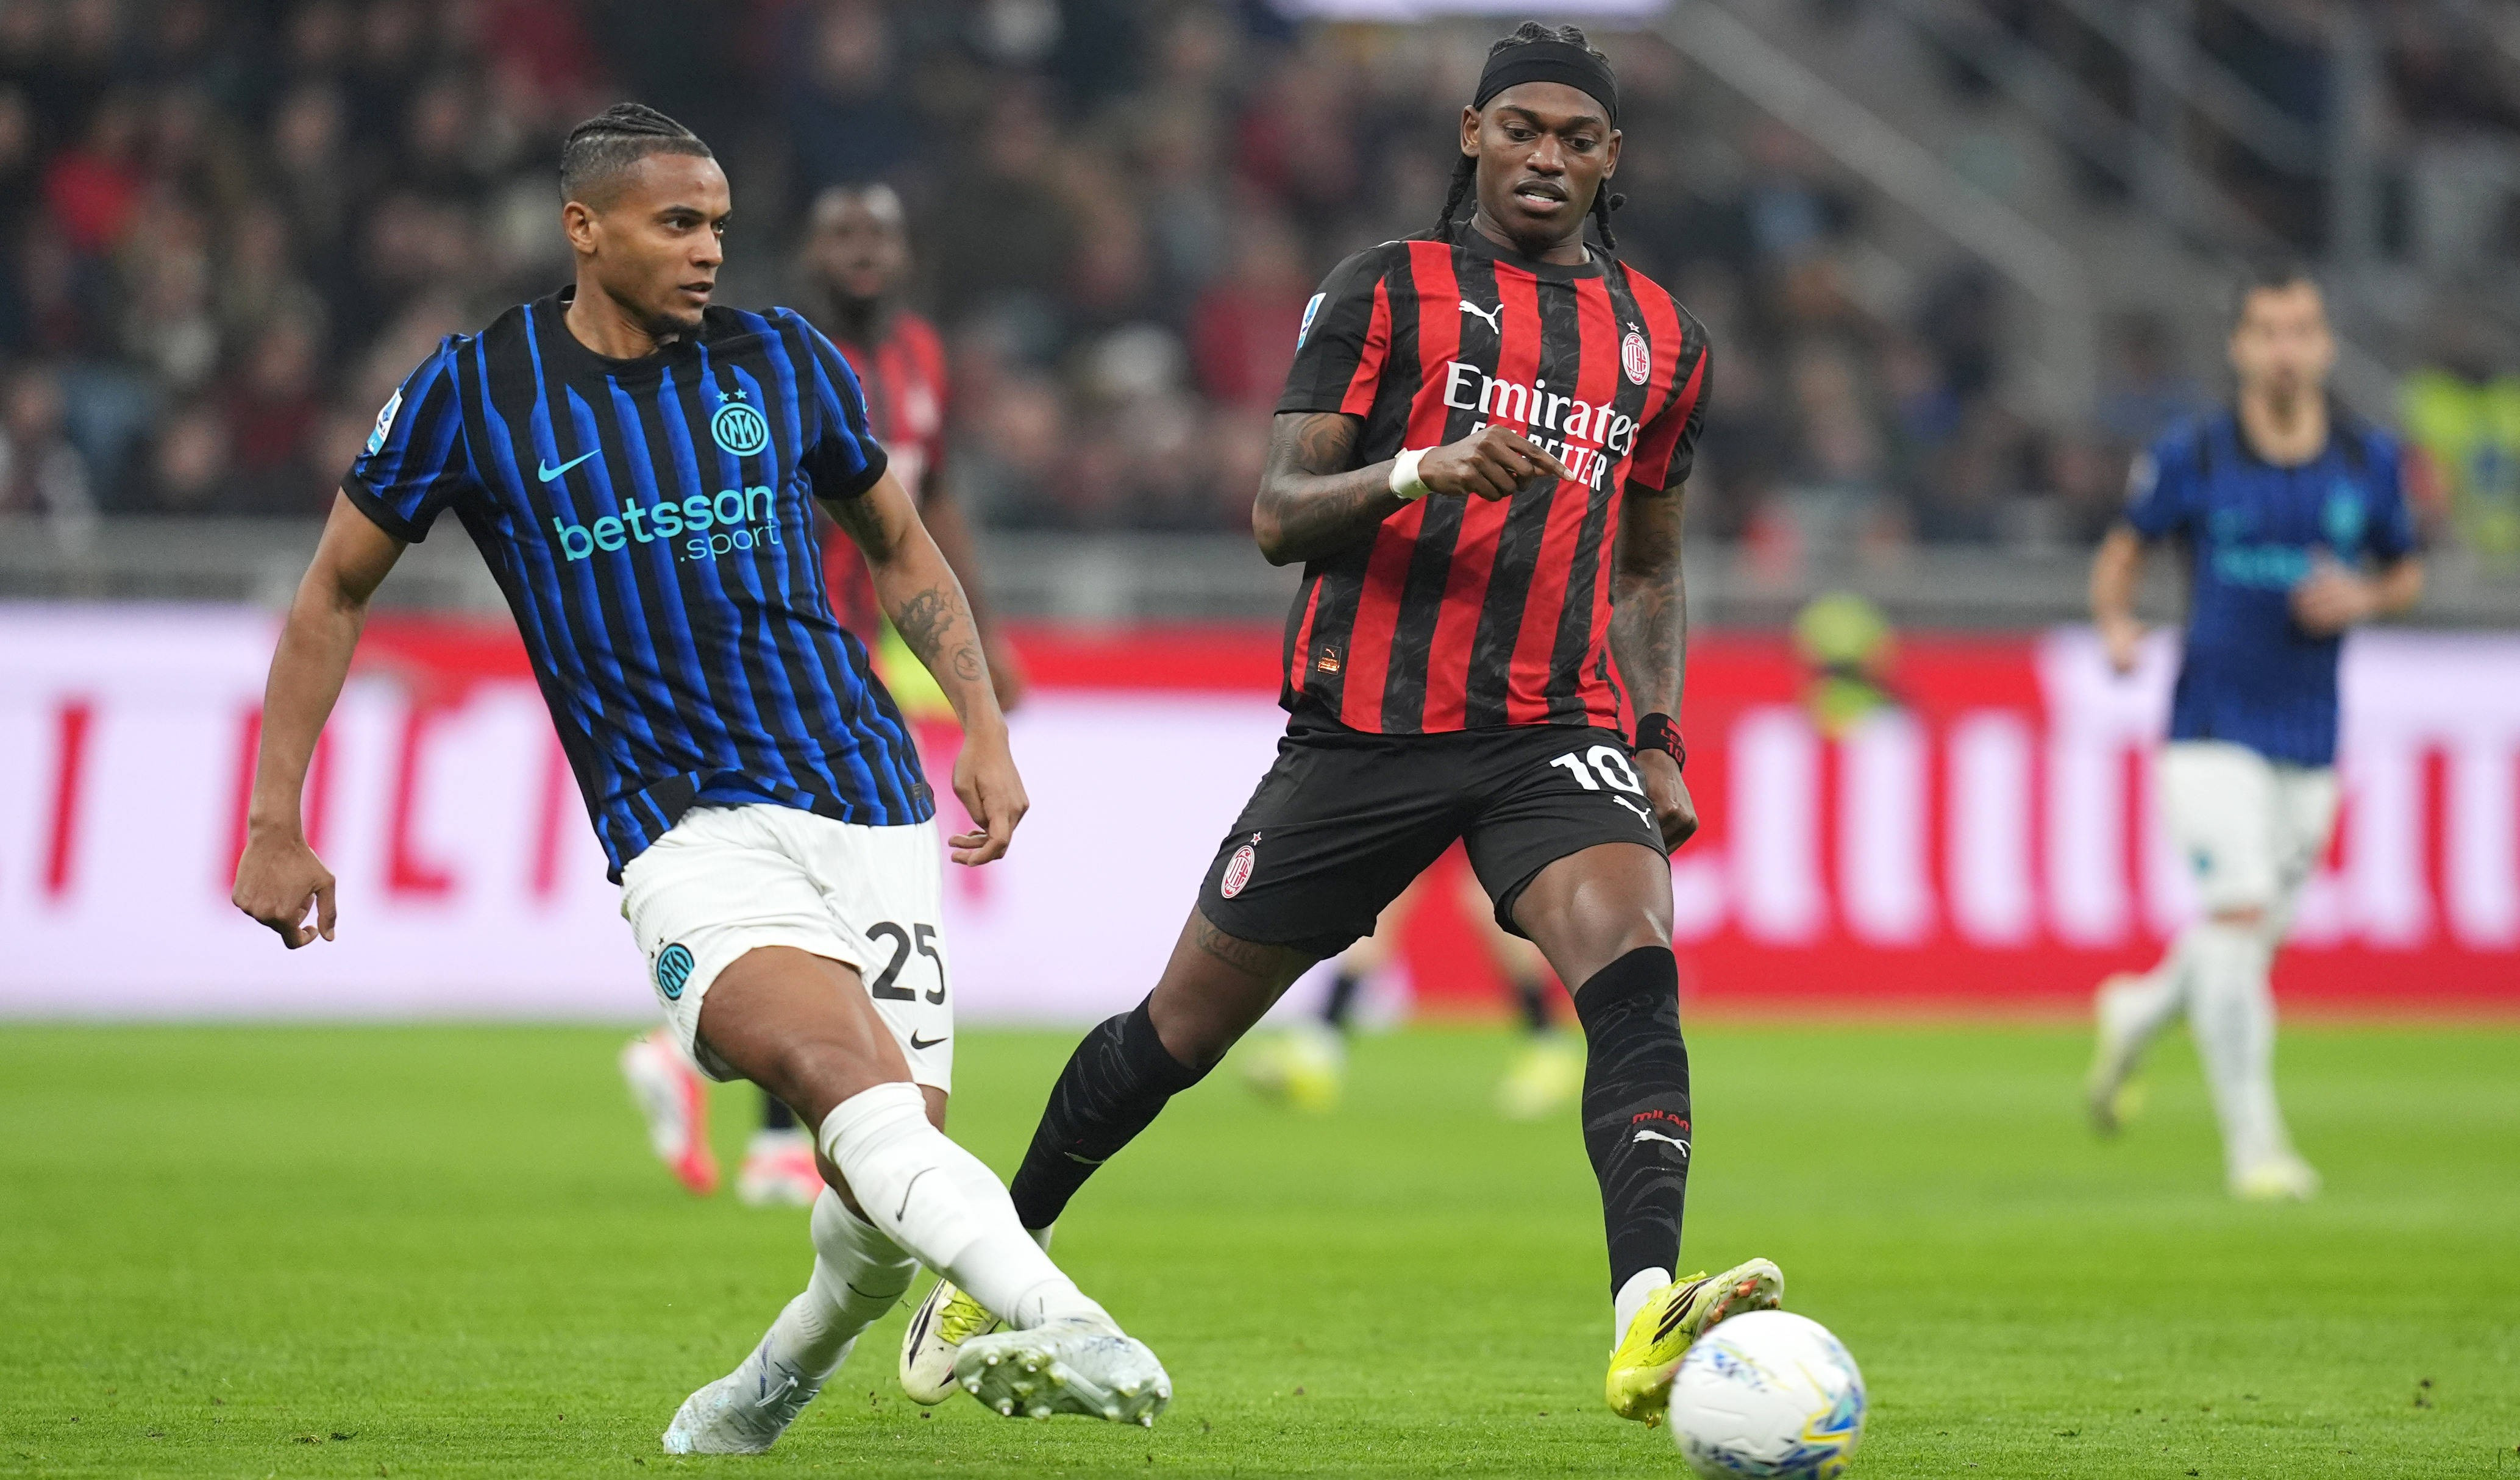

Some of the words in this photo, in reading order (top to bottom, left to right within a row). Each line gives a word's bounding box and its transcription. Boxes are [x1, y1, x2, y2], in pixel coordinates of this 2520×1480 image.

[1443, 361, 1640, 457] Emirates
[553, 485, 774, 561] betsson
[680, 519, 780, 563] .sport
[1549, 745, 1644, 796] 10
[1667, 742, 1683, 763] 10
[866, 921, 945, 1005] 25
